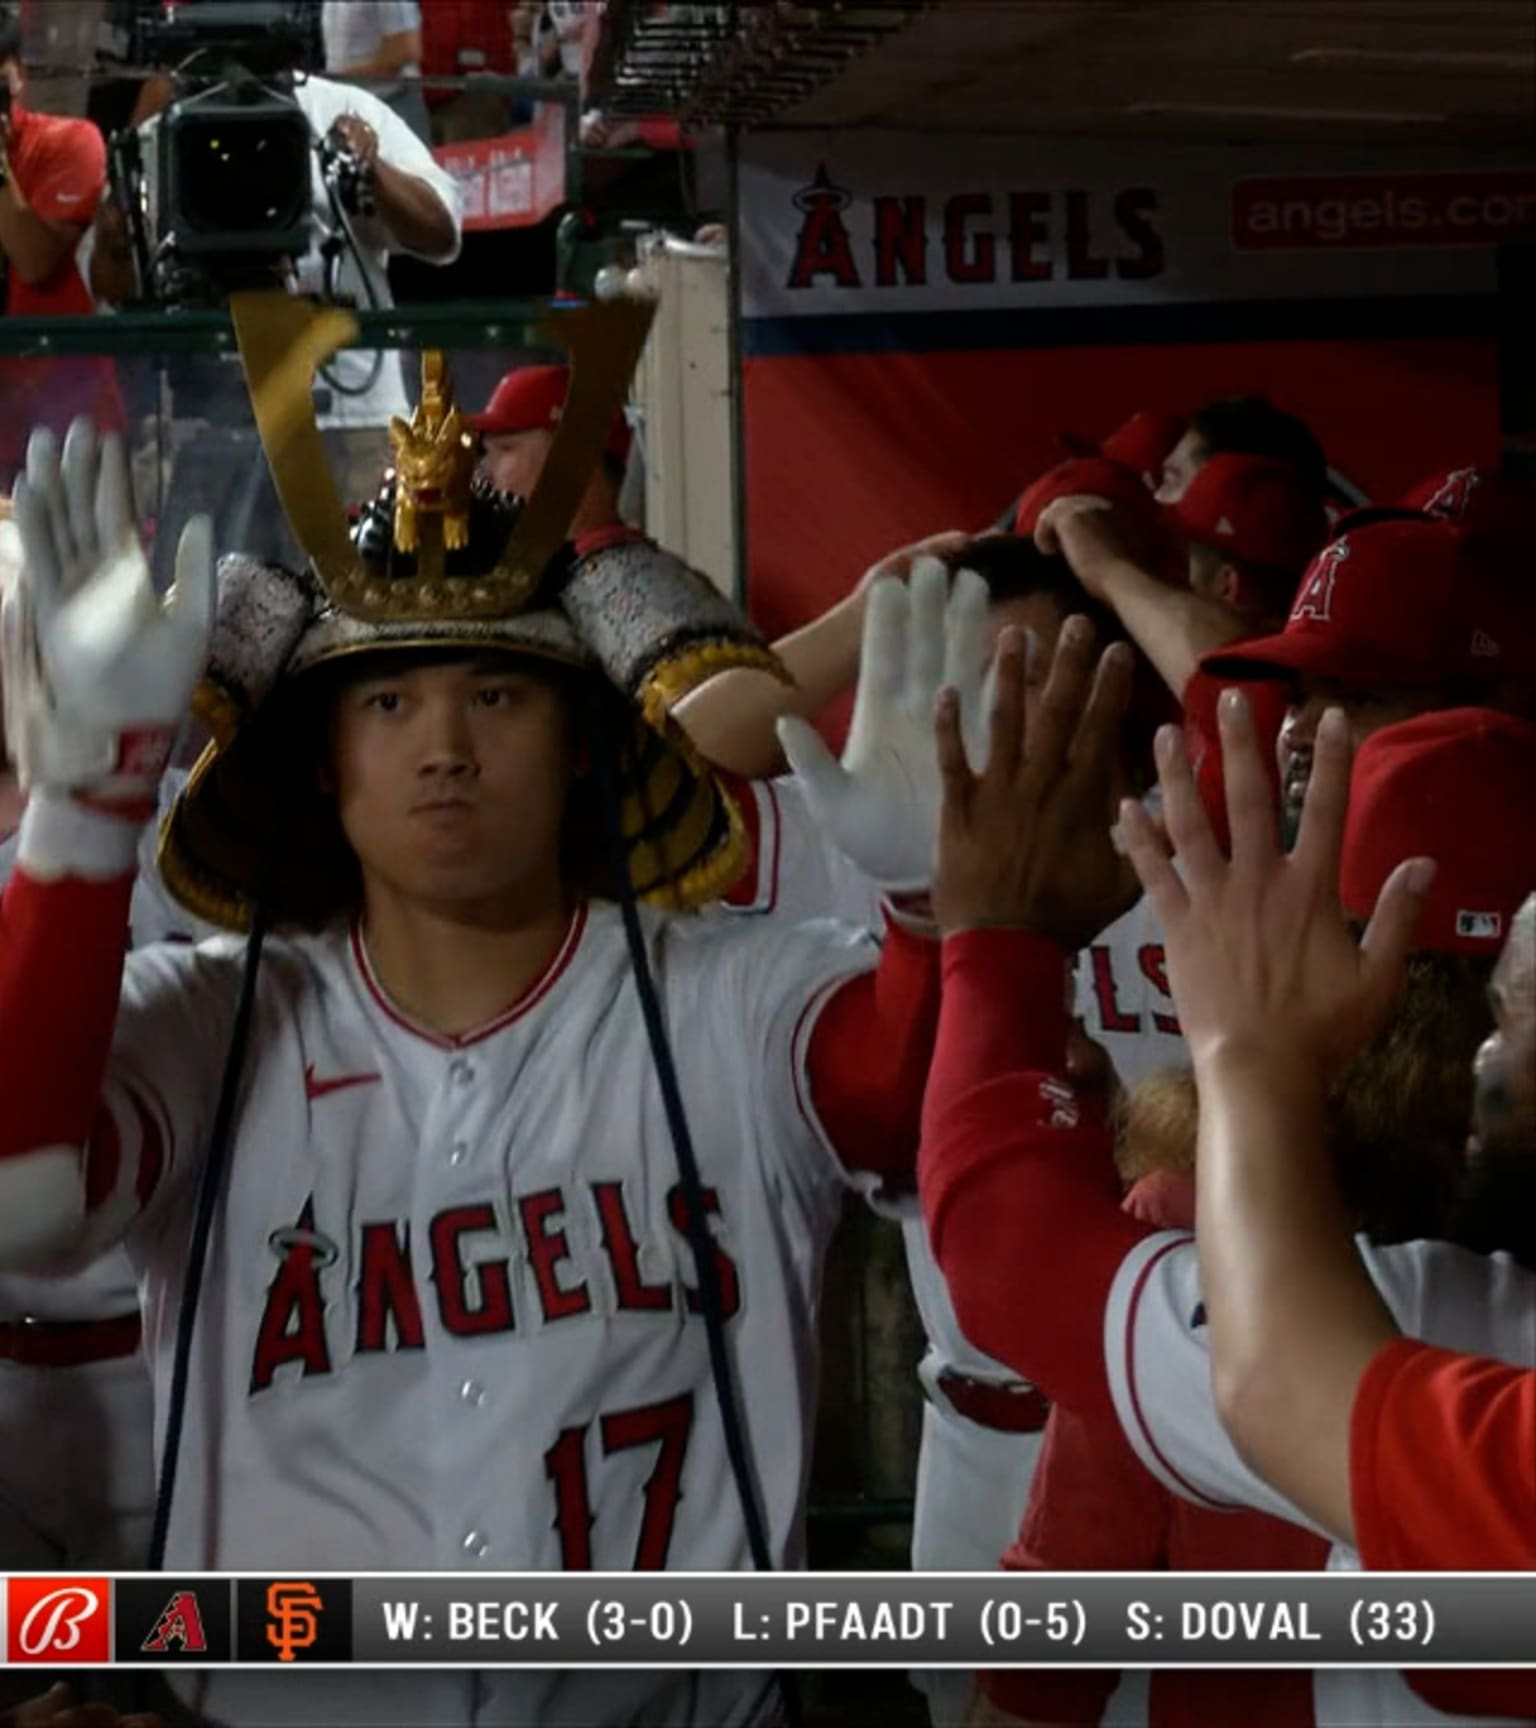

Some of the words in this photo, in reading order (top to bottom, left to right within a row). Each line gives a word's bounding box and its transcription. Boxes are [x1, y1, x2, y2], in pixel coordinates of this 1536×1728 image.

[786, 160, 1166, 289] ANGELS
[1289, 533, 1351, 622] A
[249, 1181, 742, 1397] ANGELS
[545, 1389, 696, 1572] 17
